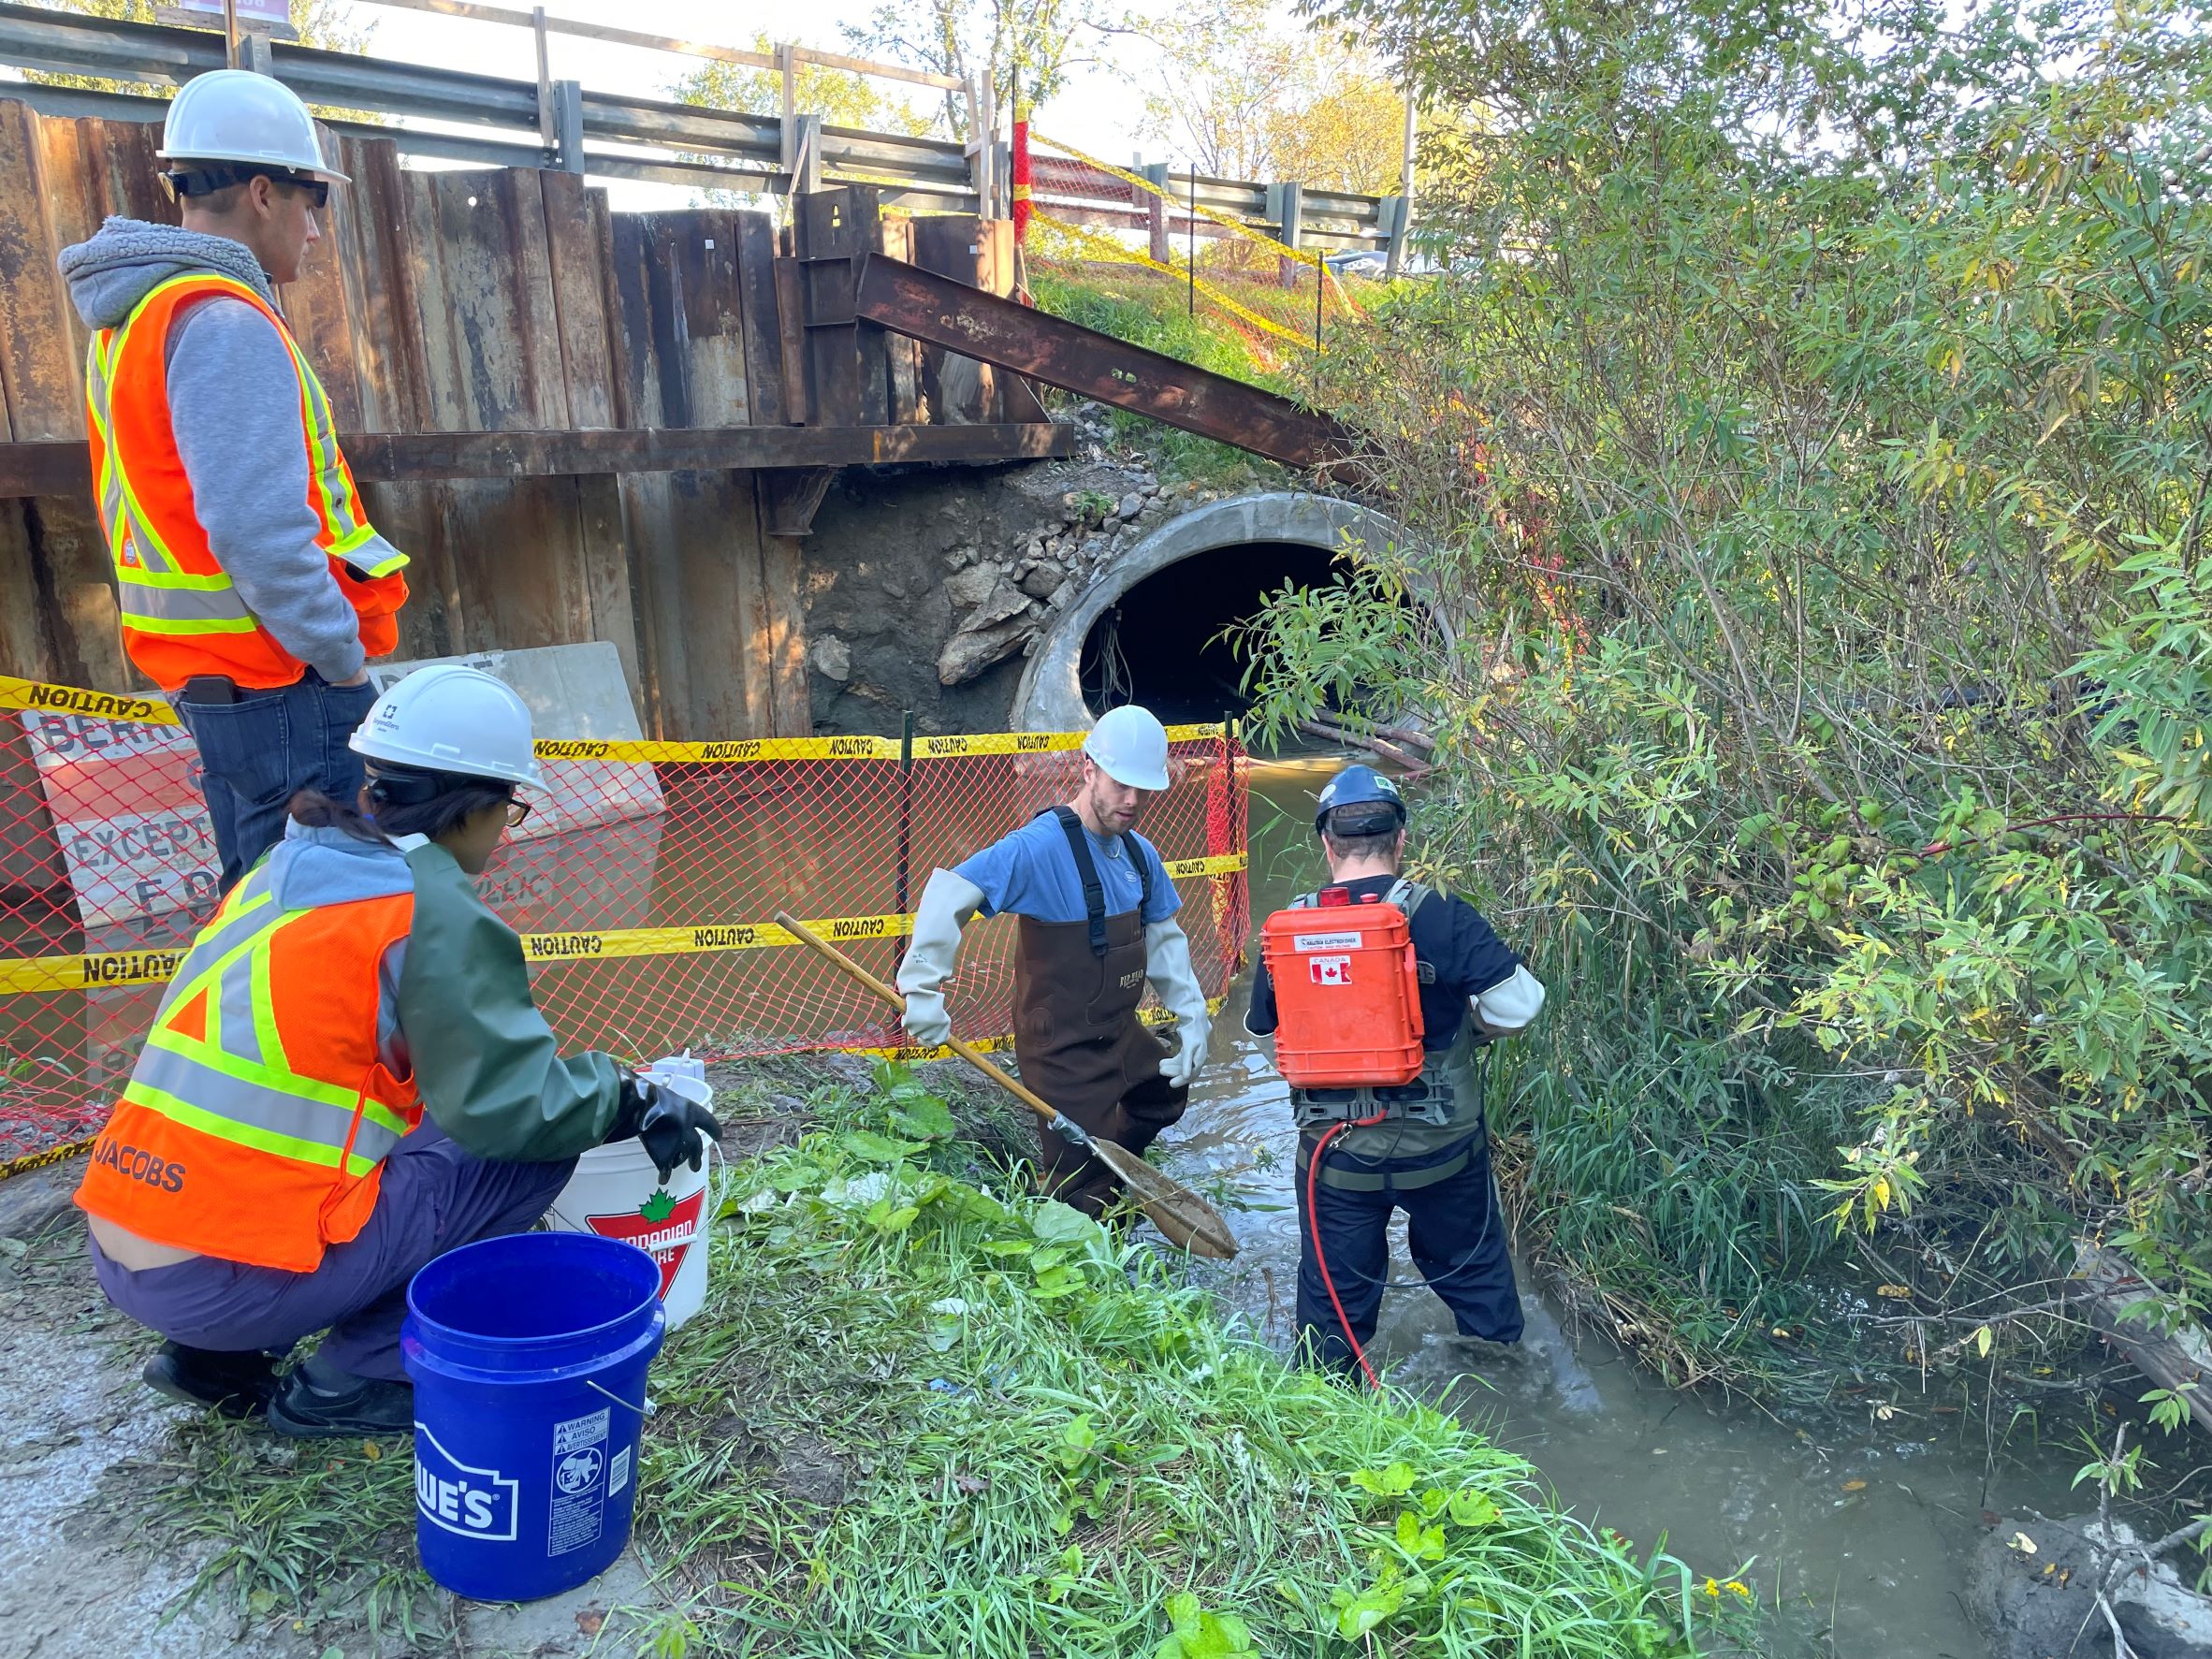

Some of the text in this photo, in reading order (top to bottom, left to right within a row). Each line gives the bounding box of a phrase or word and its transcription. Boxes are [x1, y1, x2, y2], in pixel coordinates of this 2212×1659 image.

[28, 685, 153, 719] CAUTION
[534, 735, 1050, 759] CAUTION CAUTION CAUTION CAUTION CAUTION
[72, 816, 208, 867] EXCEPT
[1174, 860, 1206, 875] CAUTION
[833, 918, 885, 937] CAUTION
[531, 927, 755, 956] CAUTION CAUTION
[95, 1136, 186, 1193] JACOBS
[567, 1412, 605, 1432] WARNING
[572, 1426, 596, 1440] AVISO
[566, 1432, 606, 1451] AVERTISSEMENT
